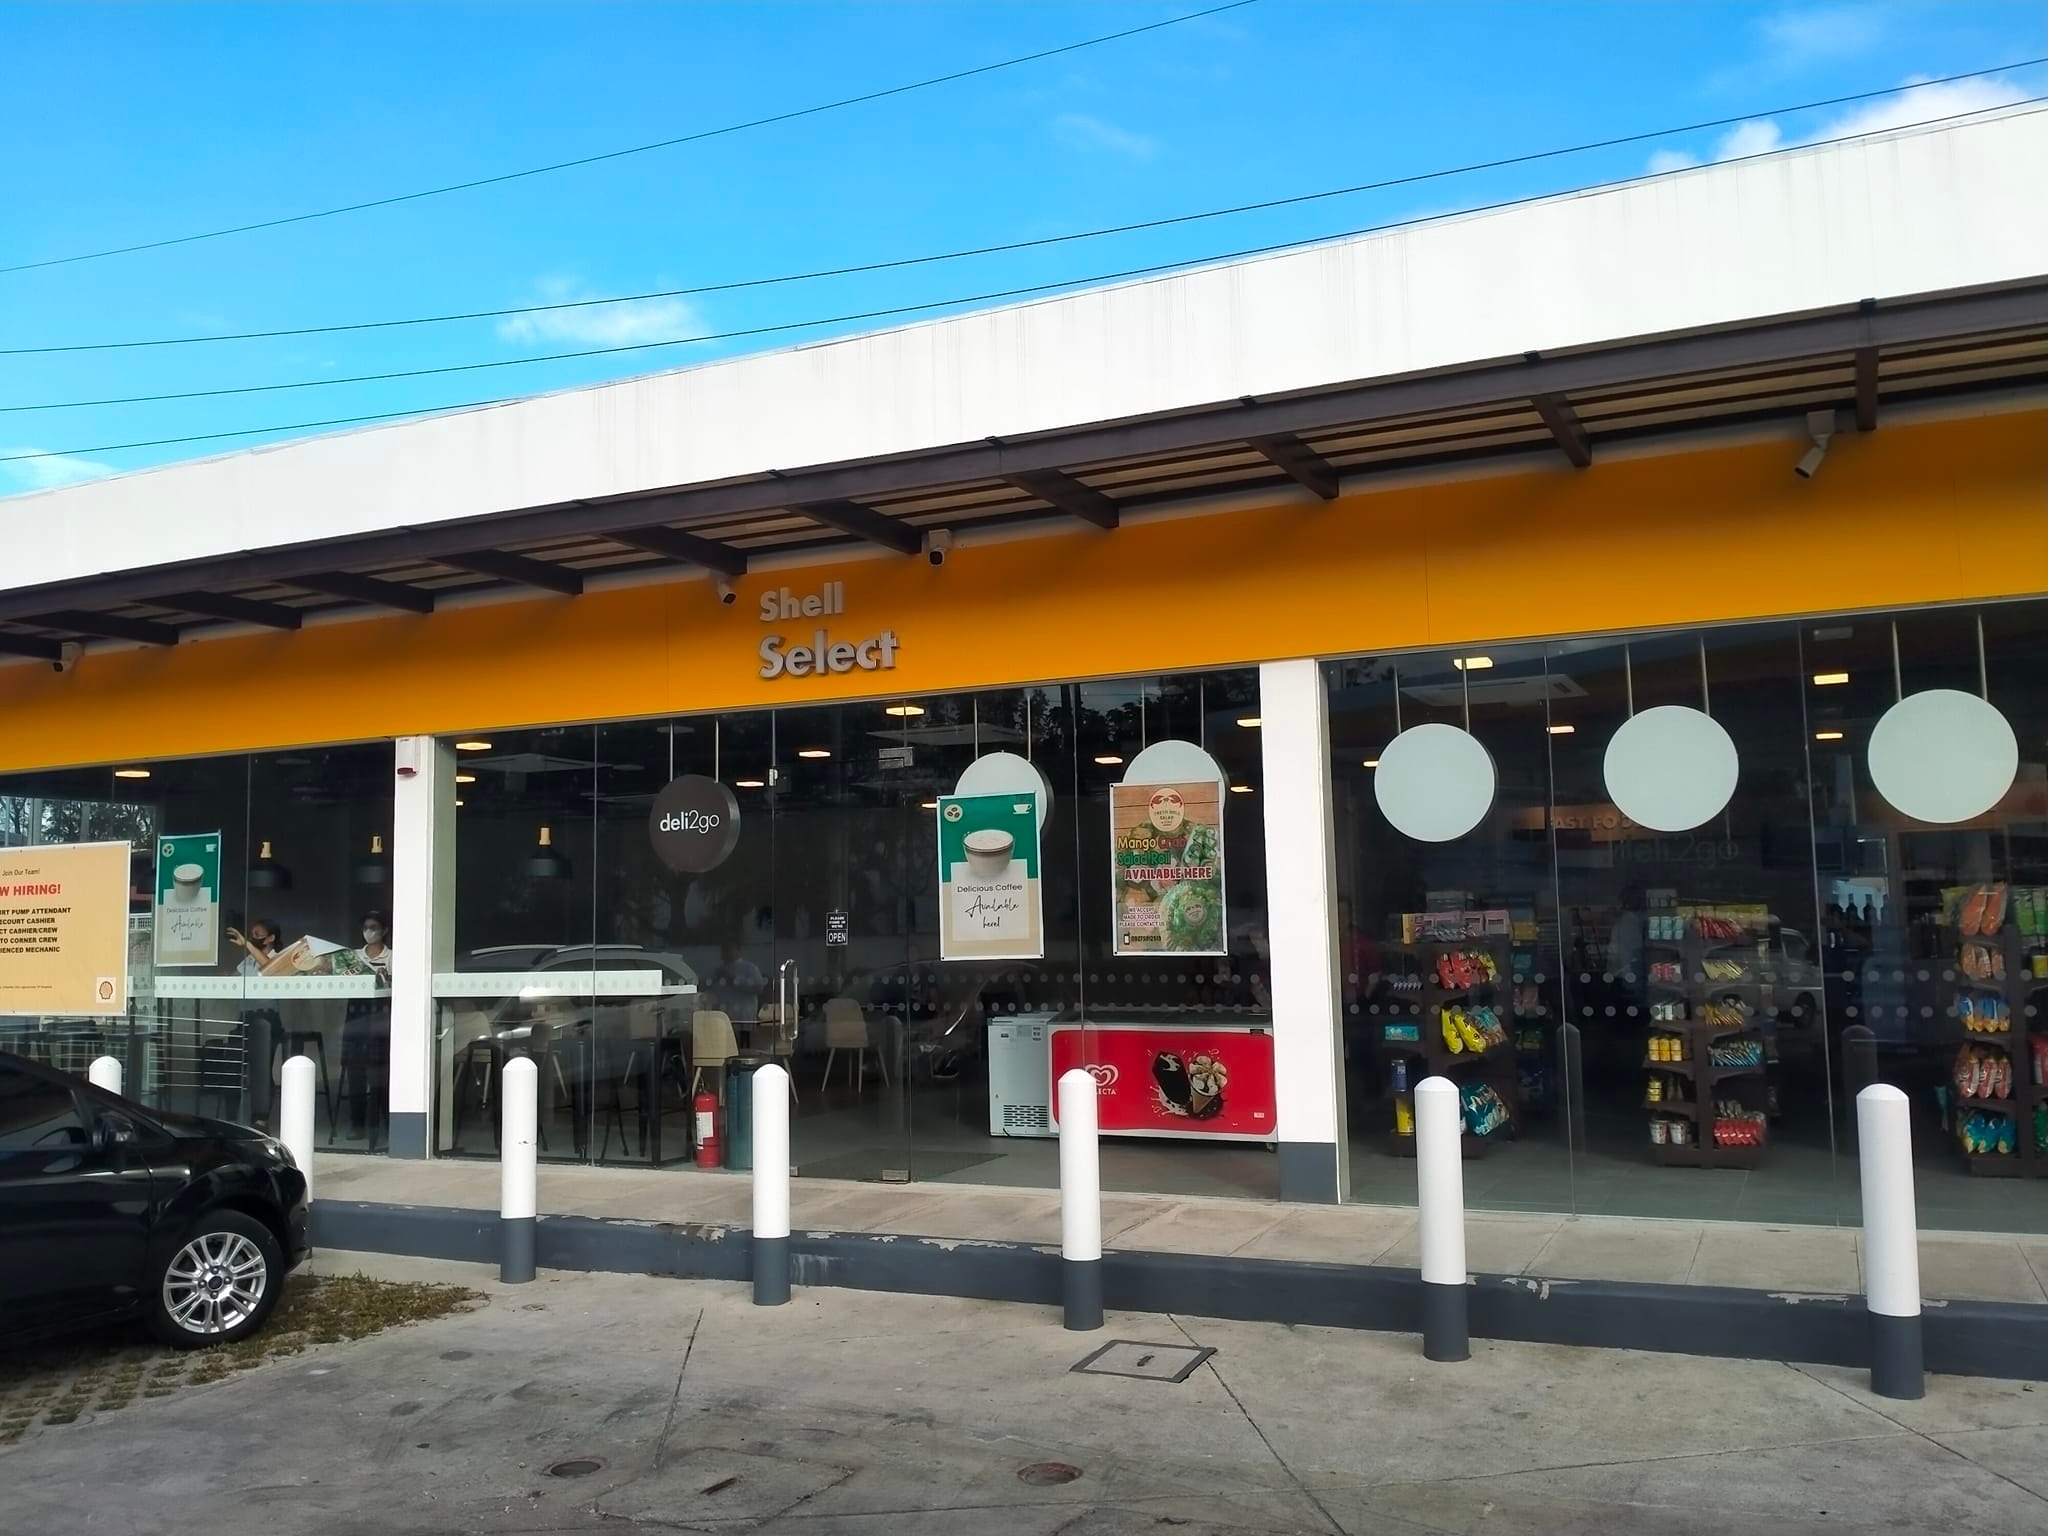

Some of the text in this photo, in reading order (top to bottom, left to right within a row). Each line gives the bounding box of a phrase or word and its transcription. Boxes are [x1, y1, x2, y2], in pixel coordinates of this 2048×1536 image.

[760, 581, 843, 621] Shell
[760, 629, 898, 679] Select
[660, 809, 720, 834] deli2go
[1117, 836, 1157, 851] Mango
[1116, 850, 1171, 865] Salad Roll
[1125, 866, 1213, 880] AVAILABLE HERE
[13, 884, 61, 896] HIRING!
[957, 883, 1023, 893] Delicious Coffee
[965, 894, 1019, 918] Available
[983, 916, 1000, 928] here!
[828, 932, 846, 943] OPEN
